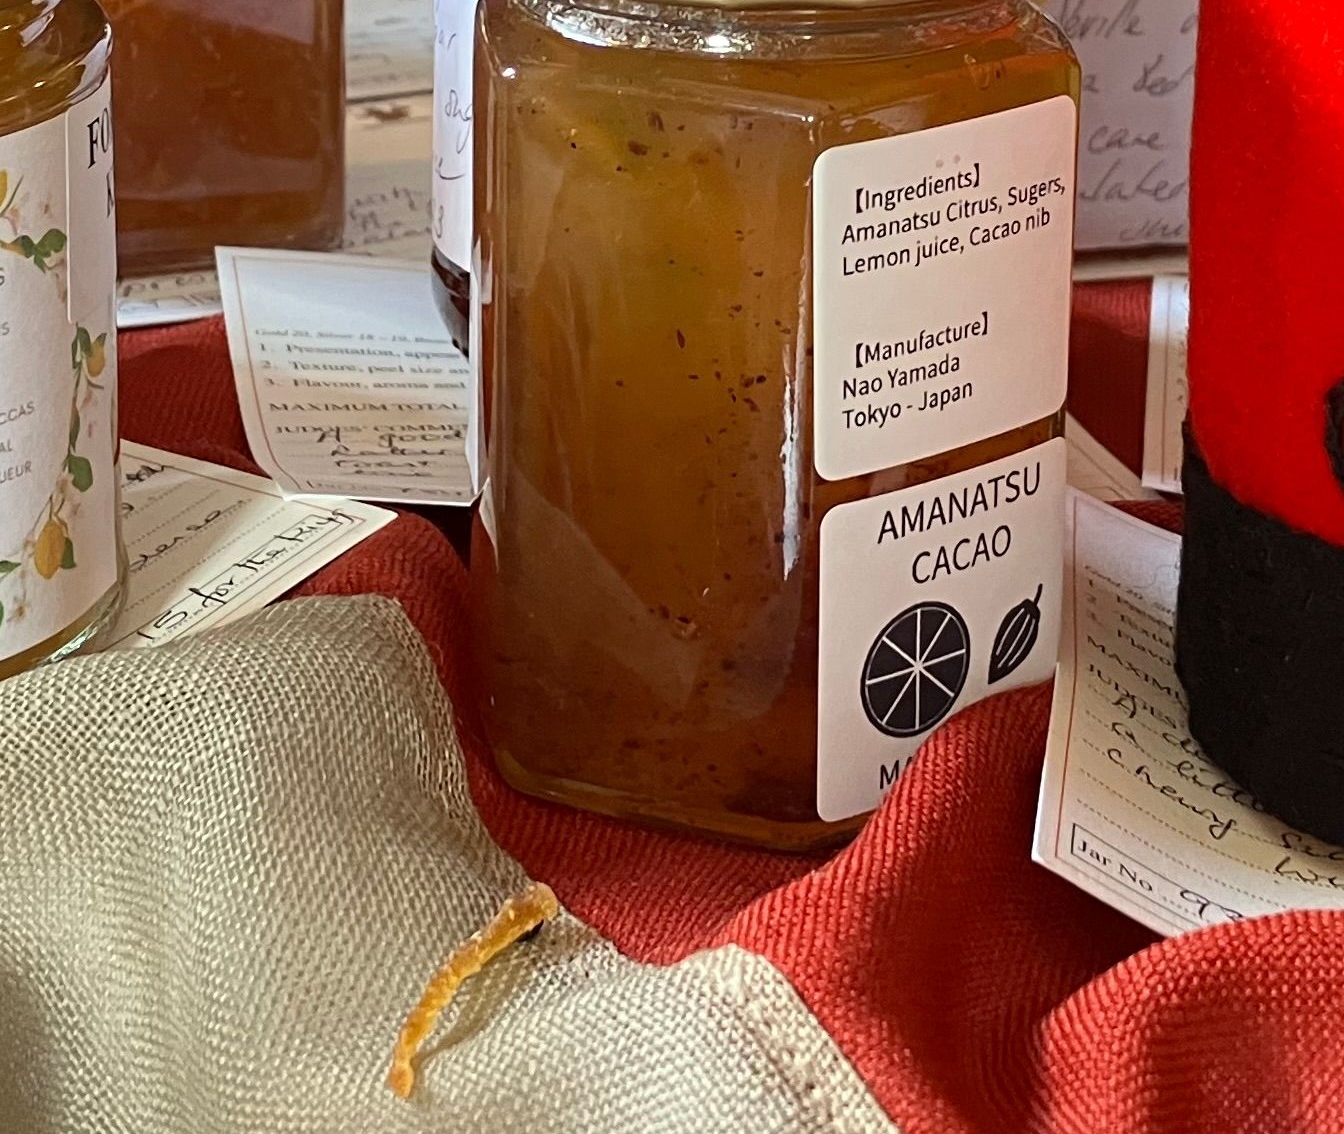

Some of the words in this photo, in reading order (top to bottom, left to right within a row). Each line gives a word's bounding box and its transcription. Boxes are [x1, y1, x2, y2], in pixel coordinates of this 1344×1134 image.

[841, 209, 941, 245] Amanatsu
[946, 195, 1002, 223] Citrus,
[1008, 175, 1066, 207] Sugers,
[843, 247, 910, 277] Lemon
[915, 233, 965, 267] juice,
[969, 219, 1021, 247] Cacao
[1026, 207, 1051, 232] nib
[842, 398, 902, 430] Tokyo
[918, 381, 973, 412] Japan
[843, 373, 882, 400] Nao
[887, 355, 960, 390] Yamada
[269, 403, 388, 412] MAXIMUM
[877, 462, 1041, 545] AMANATSU
[911, 525, 1012, 585] CACAO
[1077, 840, 1113, 868] Jar
[1119, 863, 1153, 893] No
